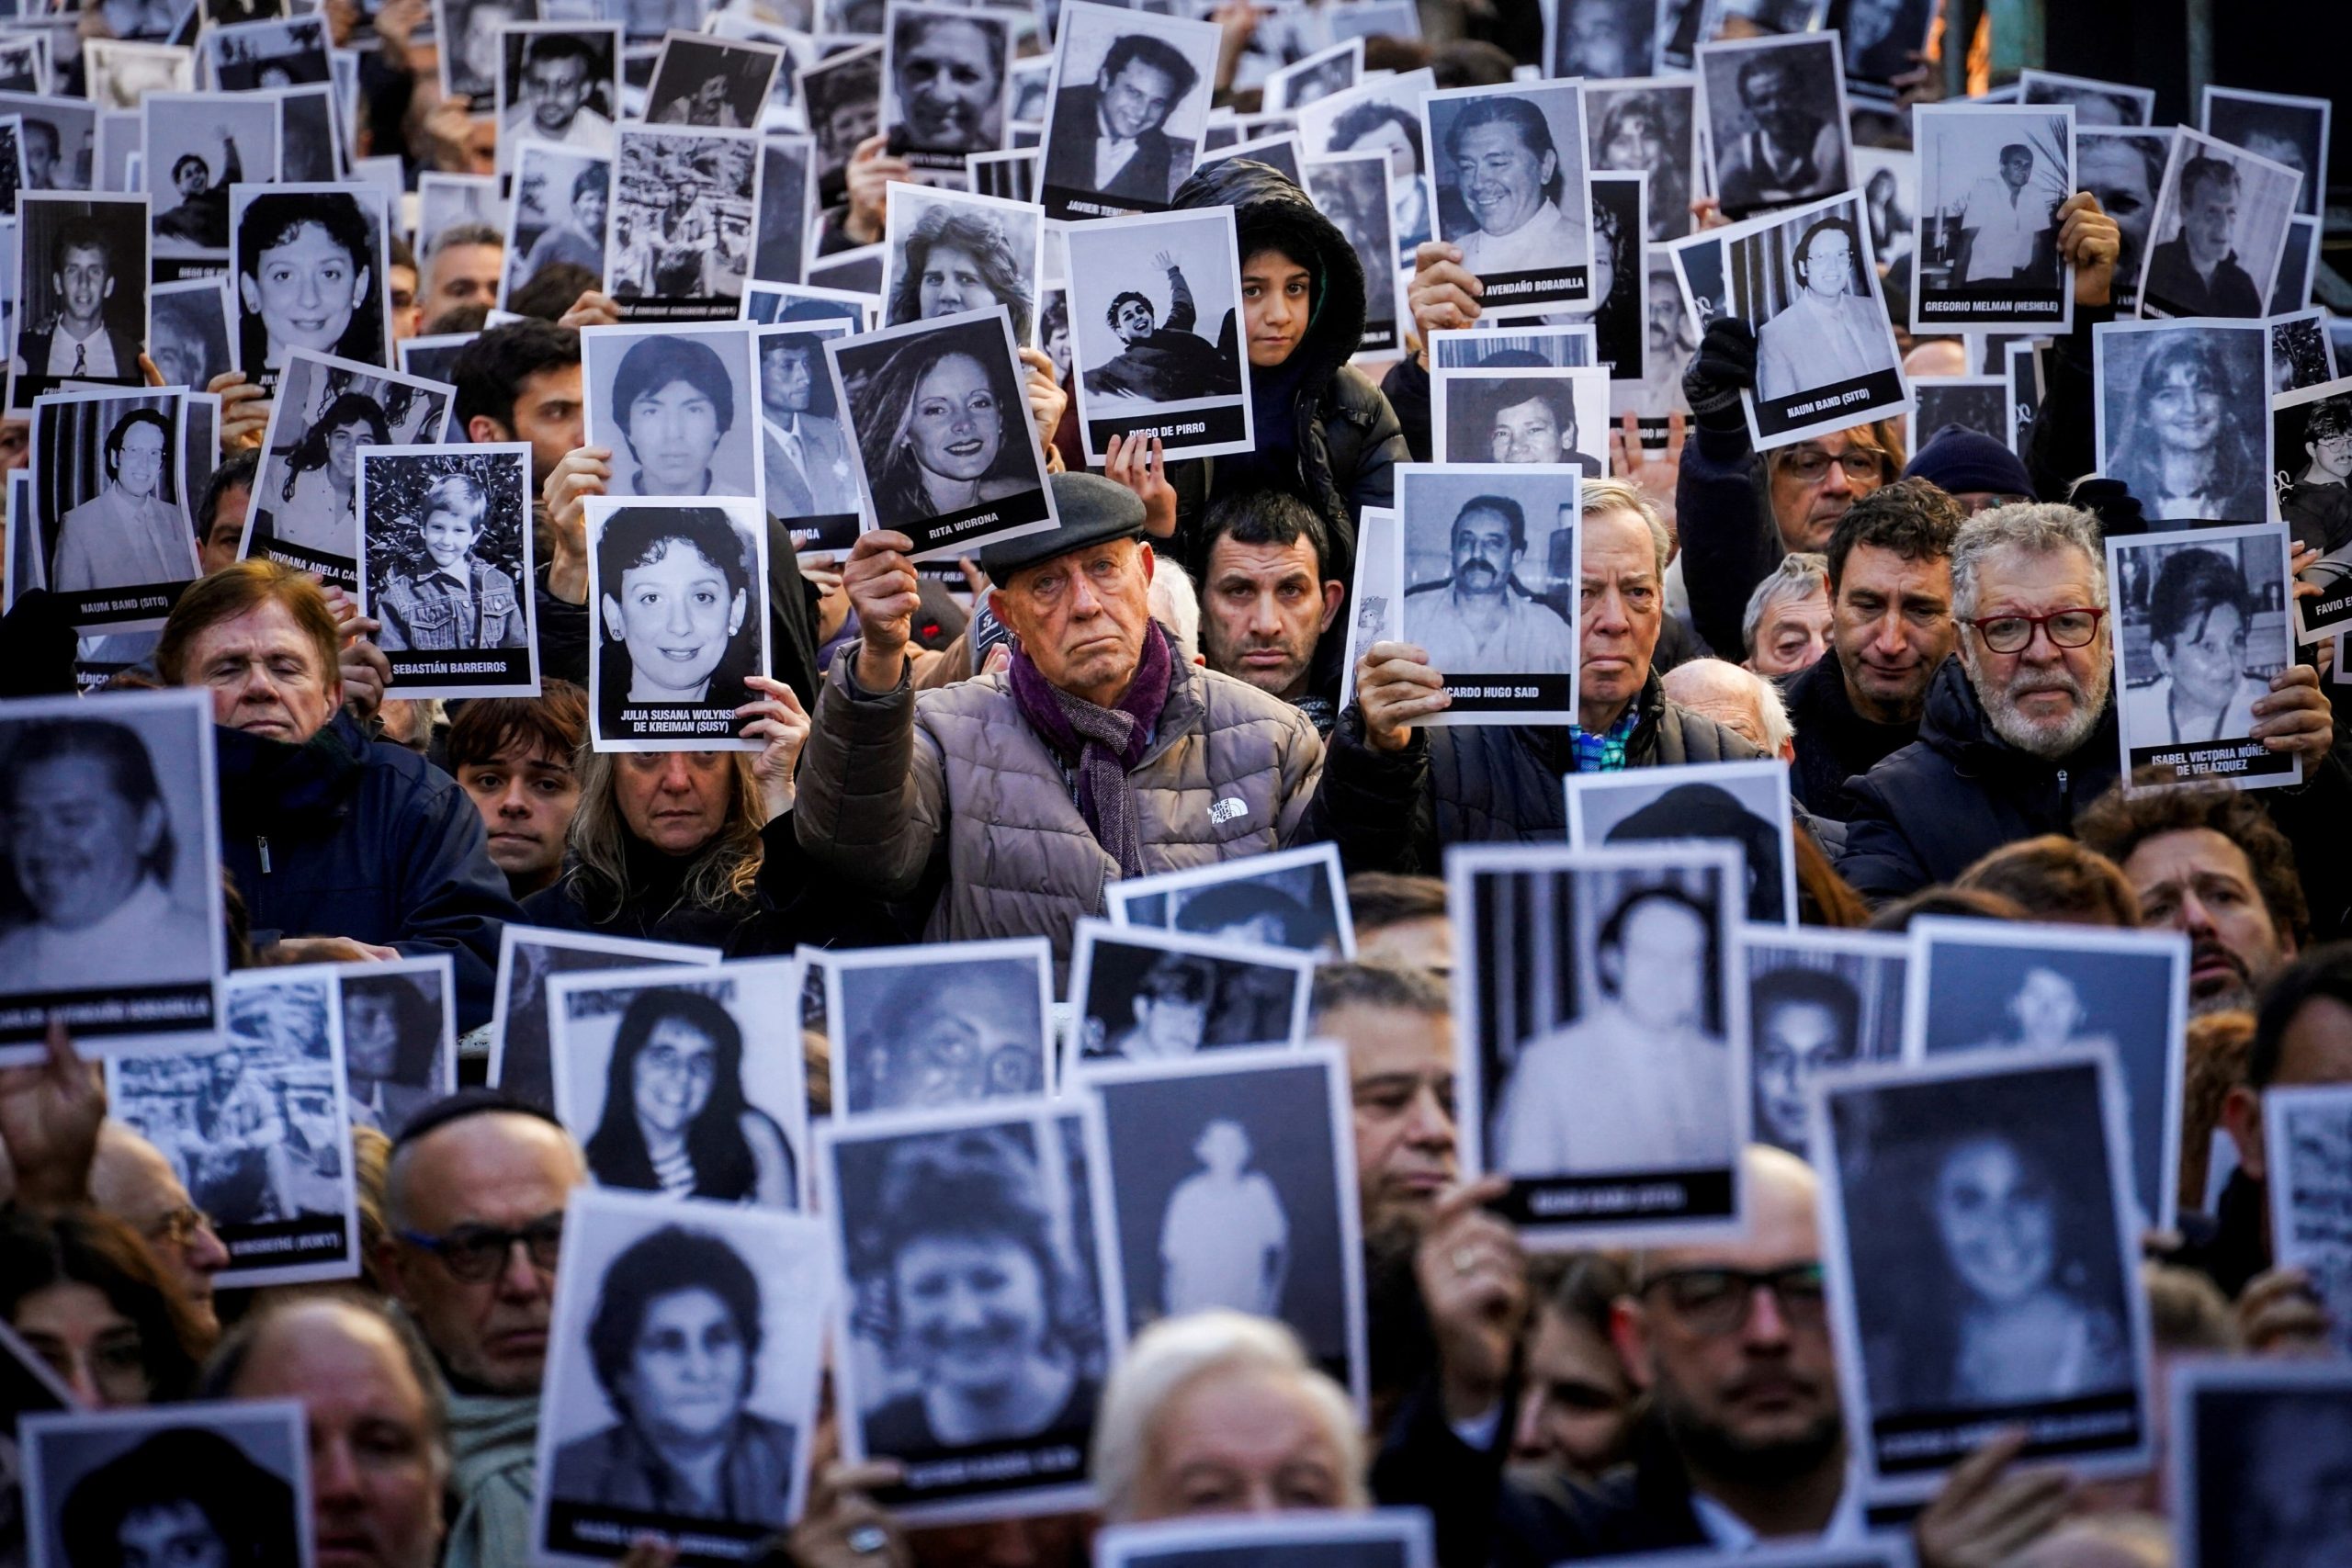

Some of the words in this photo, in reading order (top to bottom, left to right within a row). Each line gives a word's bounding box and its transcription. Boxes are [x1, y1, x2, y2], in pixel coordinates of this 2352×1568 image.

[1067, 200, 1100, 215] JAVIER
[1486, 280, 1532, 296] AVENDAÑO
[1534, 277, 1585, 292] BOBADILLA
[1926, 301, 1971, 312] GREGORIO
[1973, 301, 2012, 312] MELMAN
[2014, 301, 2059, 313] (HESHELE)
[259, 375, 278, 386] JULI
[1787, 402, 1815, 418] NAUM
[1815, 396, 1841, 411] BAND
[1842, 388, 1871, 405] (SITO)
[1160, 426, 1173, 437] DE
[1176, 422, 1206, 434] PIRRO
[929, 525, 953, 539] RITA
[954, 513, 1000, 531] WORONA
[308, 562, 340, 578] ADELA
[81, 601, 110, 614] NAUM
[111, 598, 138, 611] BAND
[141, 595, 168, 610] (SITO)
[2315, 599, 2343, 615] FAVIO
[2345, 596, 2352, 607] E
[393, 660, 447, 674] SEBASTIÁN
[450, 661, 507, 673] BARREIROS
[1484, 686, 1511, 698] HUGO
[1514, 686, 1539, 698] SAID
[621, 710, 649, 720] JULIA
[650, 710, 690, 720] SUSANA
[692, 709, 741, 720] WOLYNSK
[633, 722, 647, 732] DE
[649, 721, 695, 732] KREIMAN
[696, 721, 729, 734] (SUSY)
[2152, 753, 2188, 766] ISABEL
[2188, 749, 2236, 762] VICTORIA
[2237, 743, 2271, 758] NÚÑEZ
[2176, 764, 2190, 776] DE
[2191, 759, 2248, 775] VELÁZQUEZ
[1213, 798, 1229, 812] THE
[1211, 812, 1232, 825] FACE
